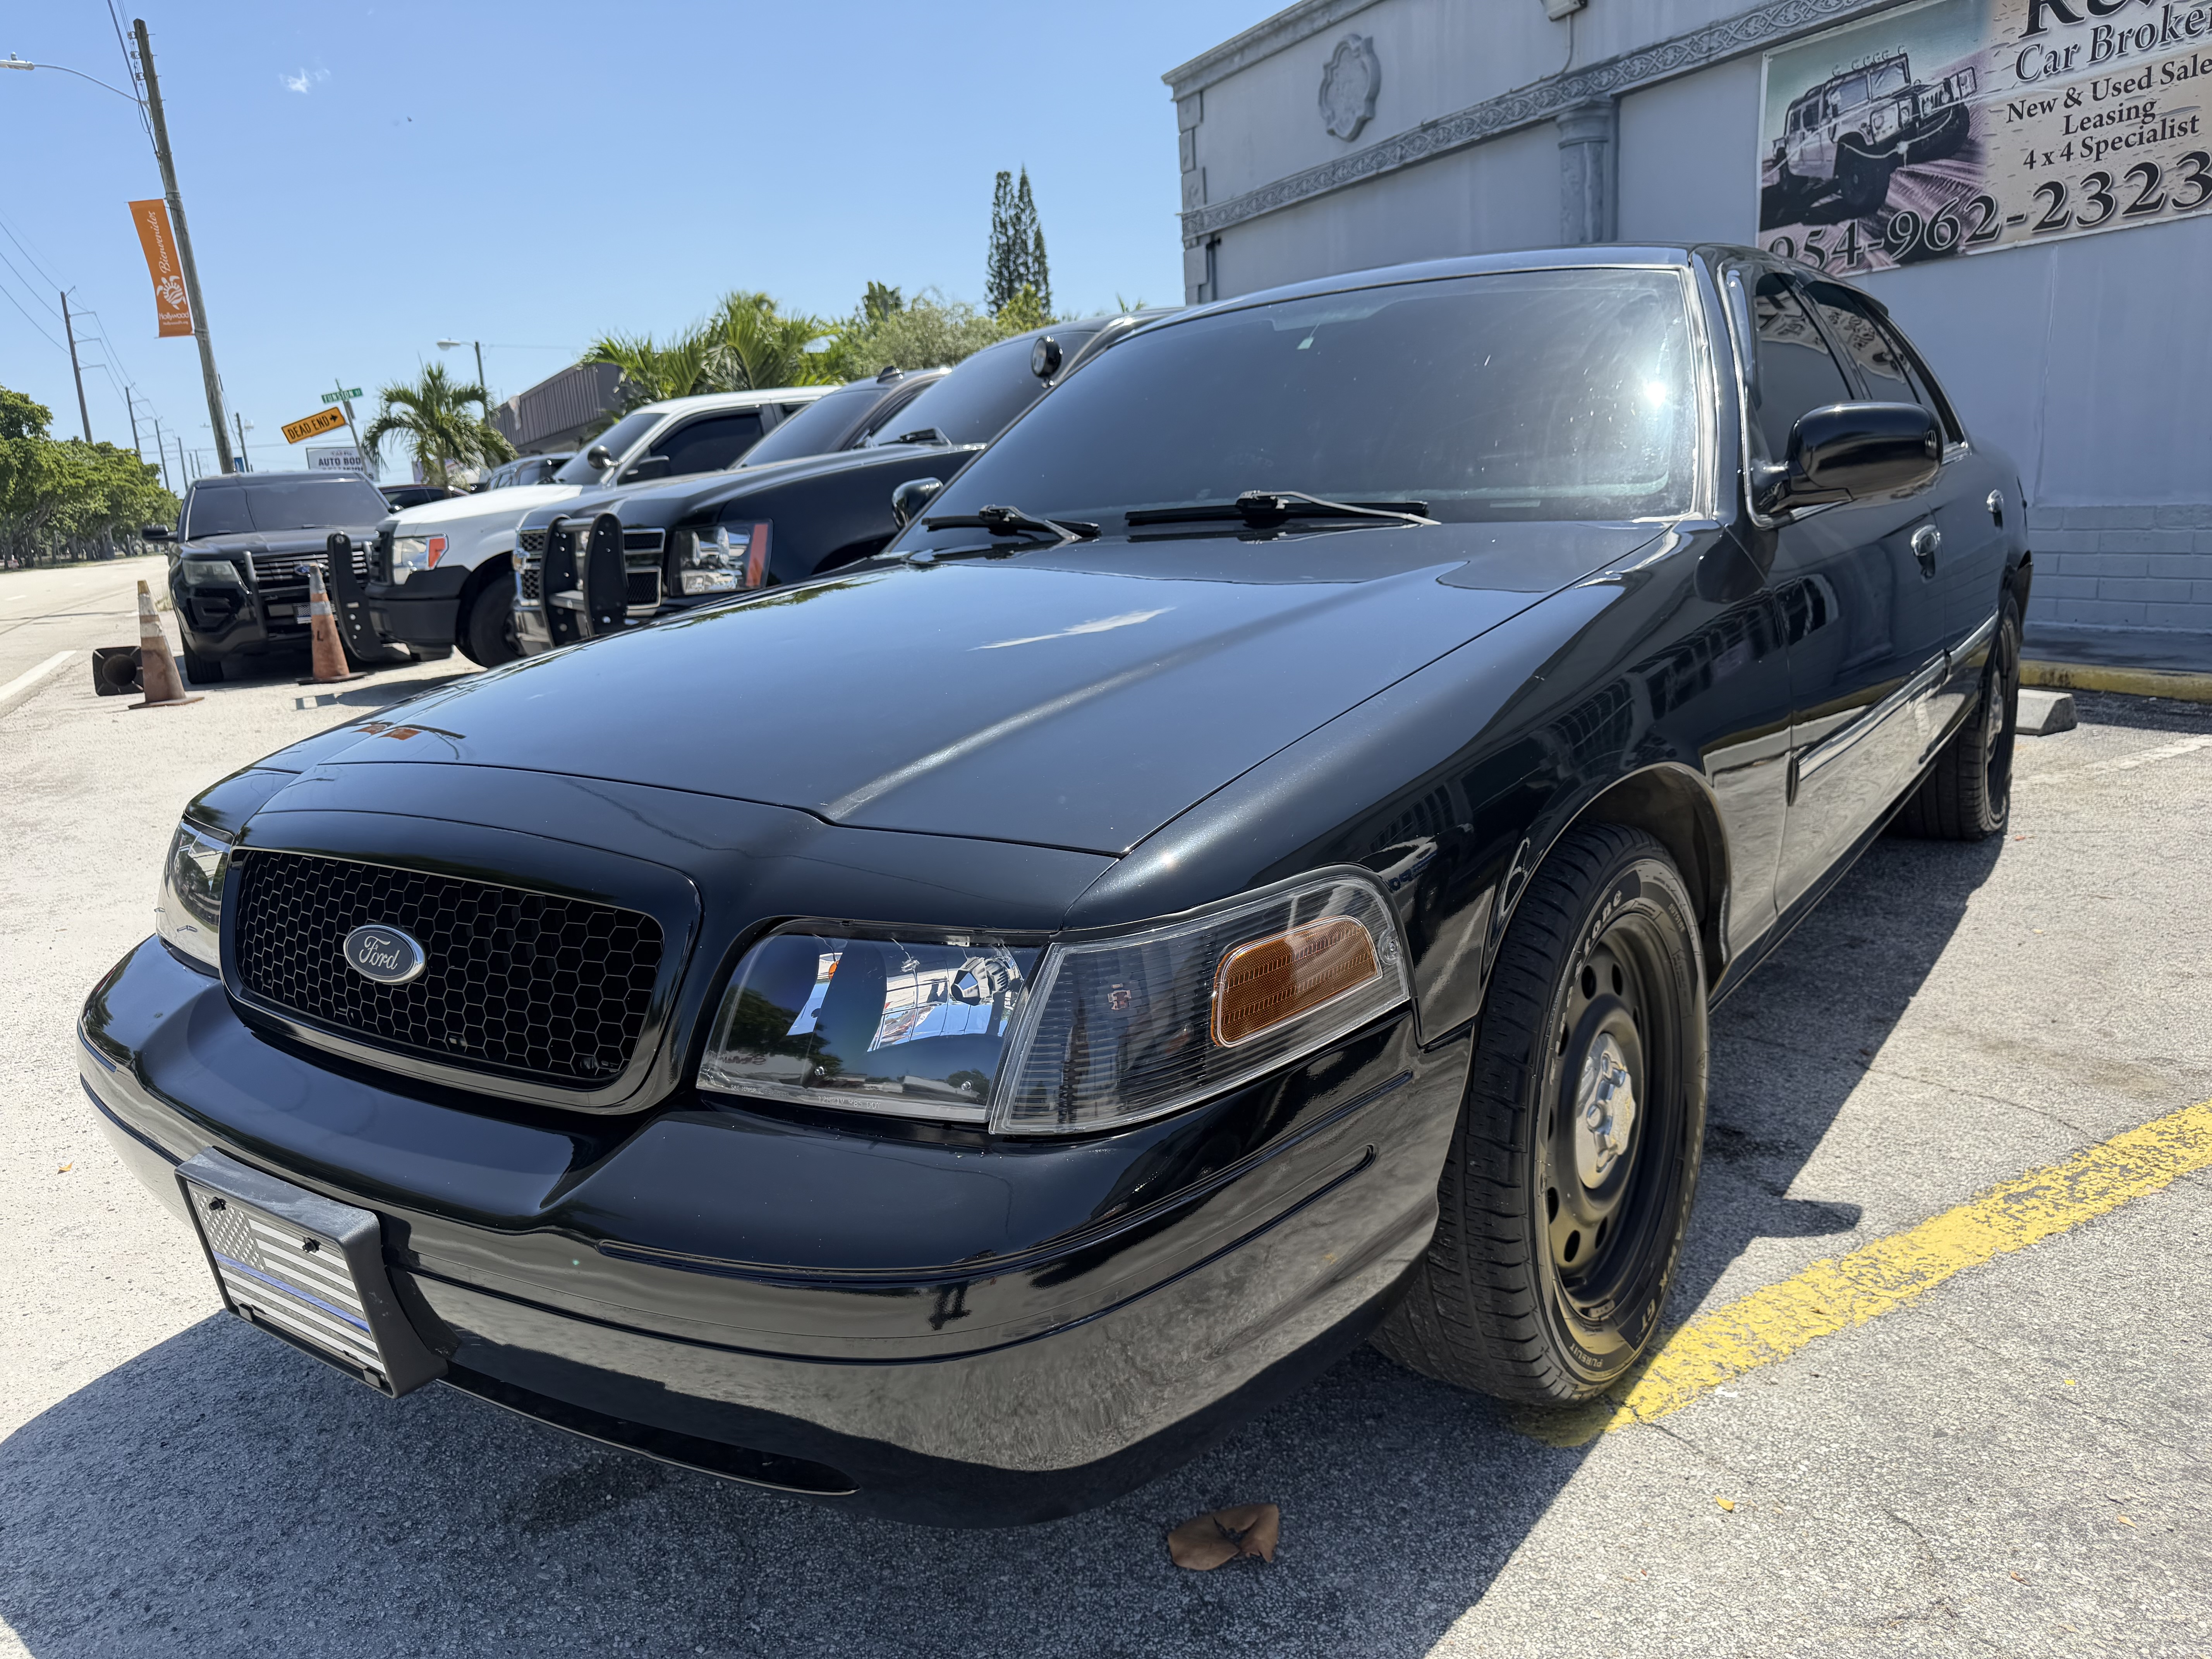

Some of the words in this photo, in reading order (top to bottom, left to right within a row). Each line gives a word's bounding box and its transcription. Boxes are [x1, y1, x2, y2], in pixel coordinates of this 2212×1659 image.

[2015, 42, 2079, 81] Car
[2006, 97, 2058, 123] New
[2063, 86, 2083, 108] &
[2091, 65, 2152, 101] Used
[2062, 99, 2157, 136] Leasing
[2023, 149, 2036, 170] 4
[2041, 151, 2055, 167] x
[2059, 141, 2074, 162] 4
[2080, 114, 2200, 162] Specialist
[147, 211, 171, 274] Bienvenidos
[158, 311, 189, 321] Hollywood
[288, 422, 311, 440] DEAD
[311, 415, 330, 430] END
[318, 457, 340, 466] AUTO
[343, 457, 361, 465] BOD
[359, 935, 400, 970] Ford
[1569, 1343, 1603, 1368] PURSUIT
